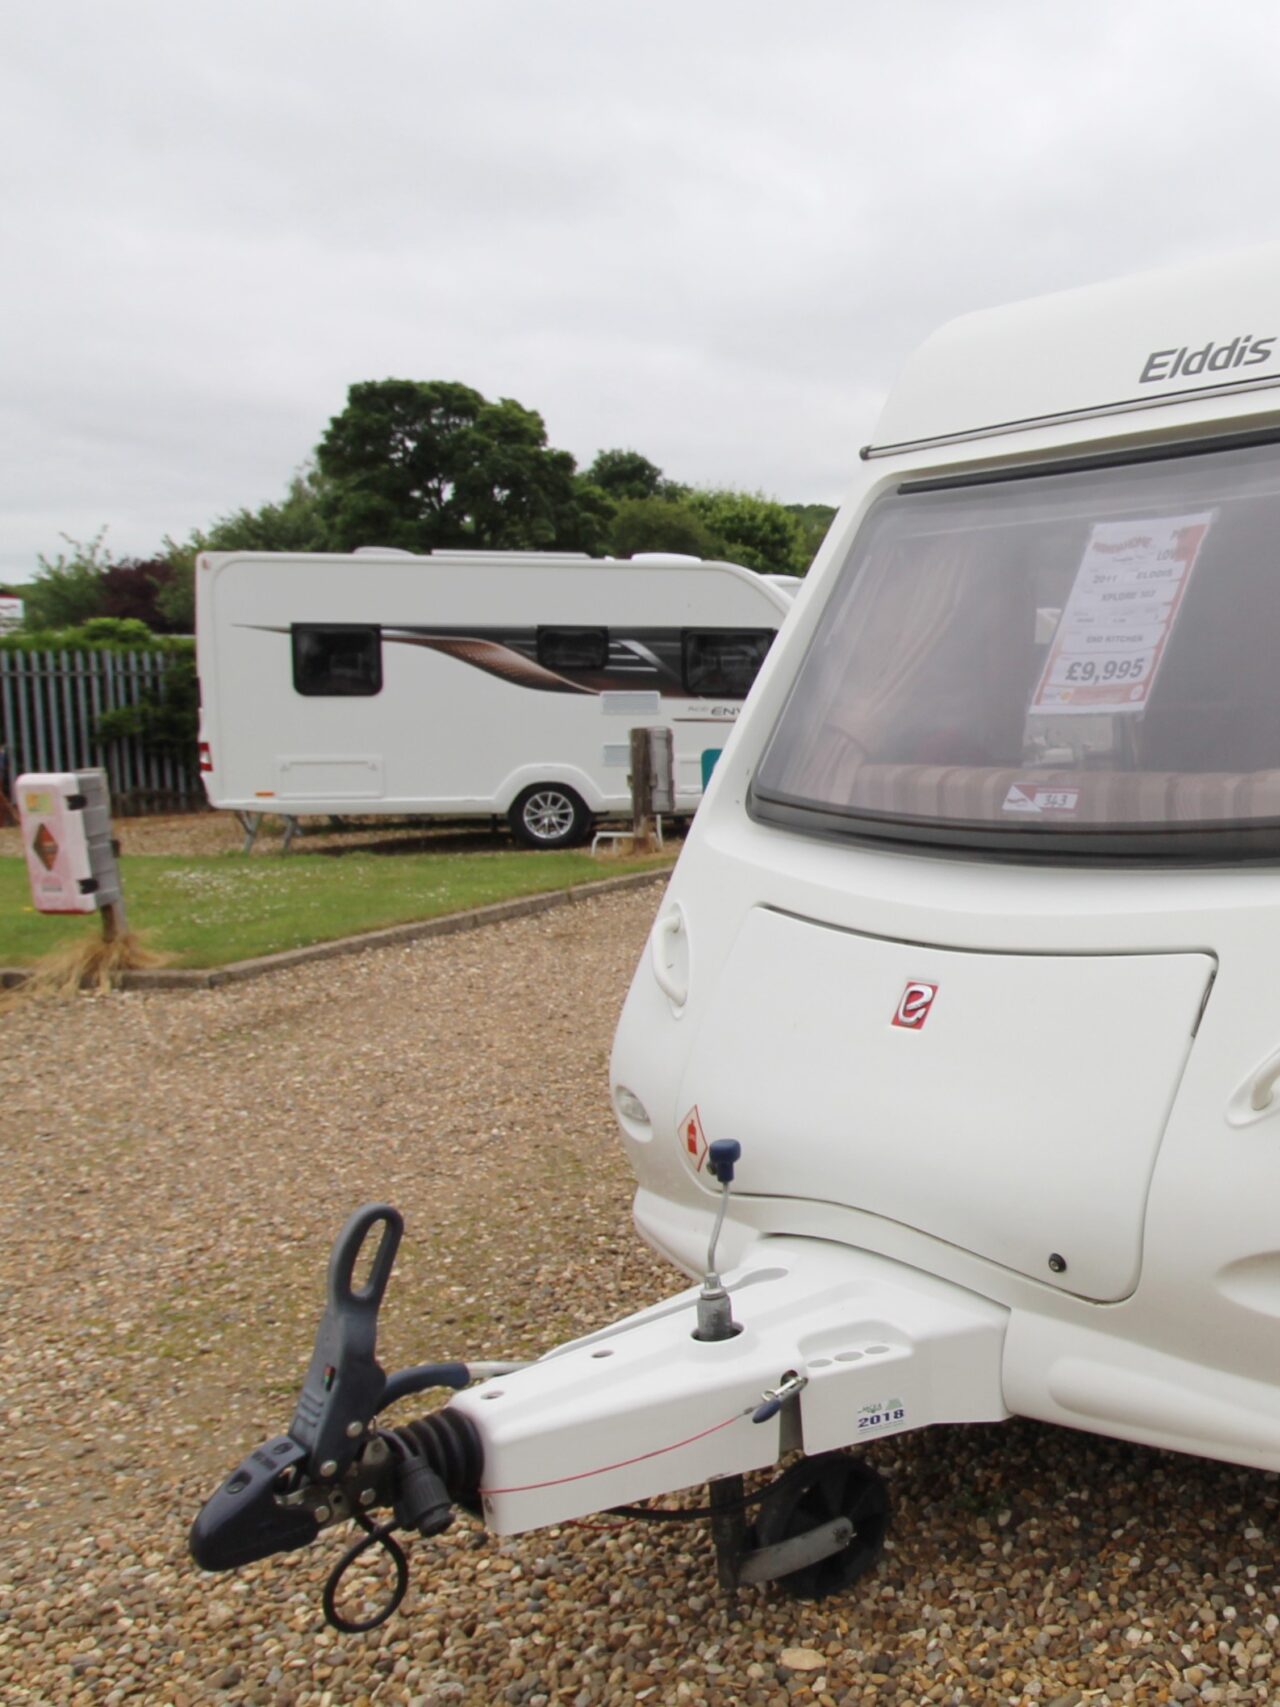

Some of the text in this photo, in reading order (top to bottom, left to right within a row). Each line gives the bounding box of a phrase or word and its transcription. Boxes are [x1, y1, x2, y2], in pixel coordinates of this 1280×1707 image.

[1139, 334, 1278, 383] Elddis
[1105, 634, 1144, 644] KITCHEN
[1065, 658, 1145, 685] £9,995
[857, 1408, 904, 1429] 2018
